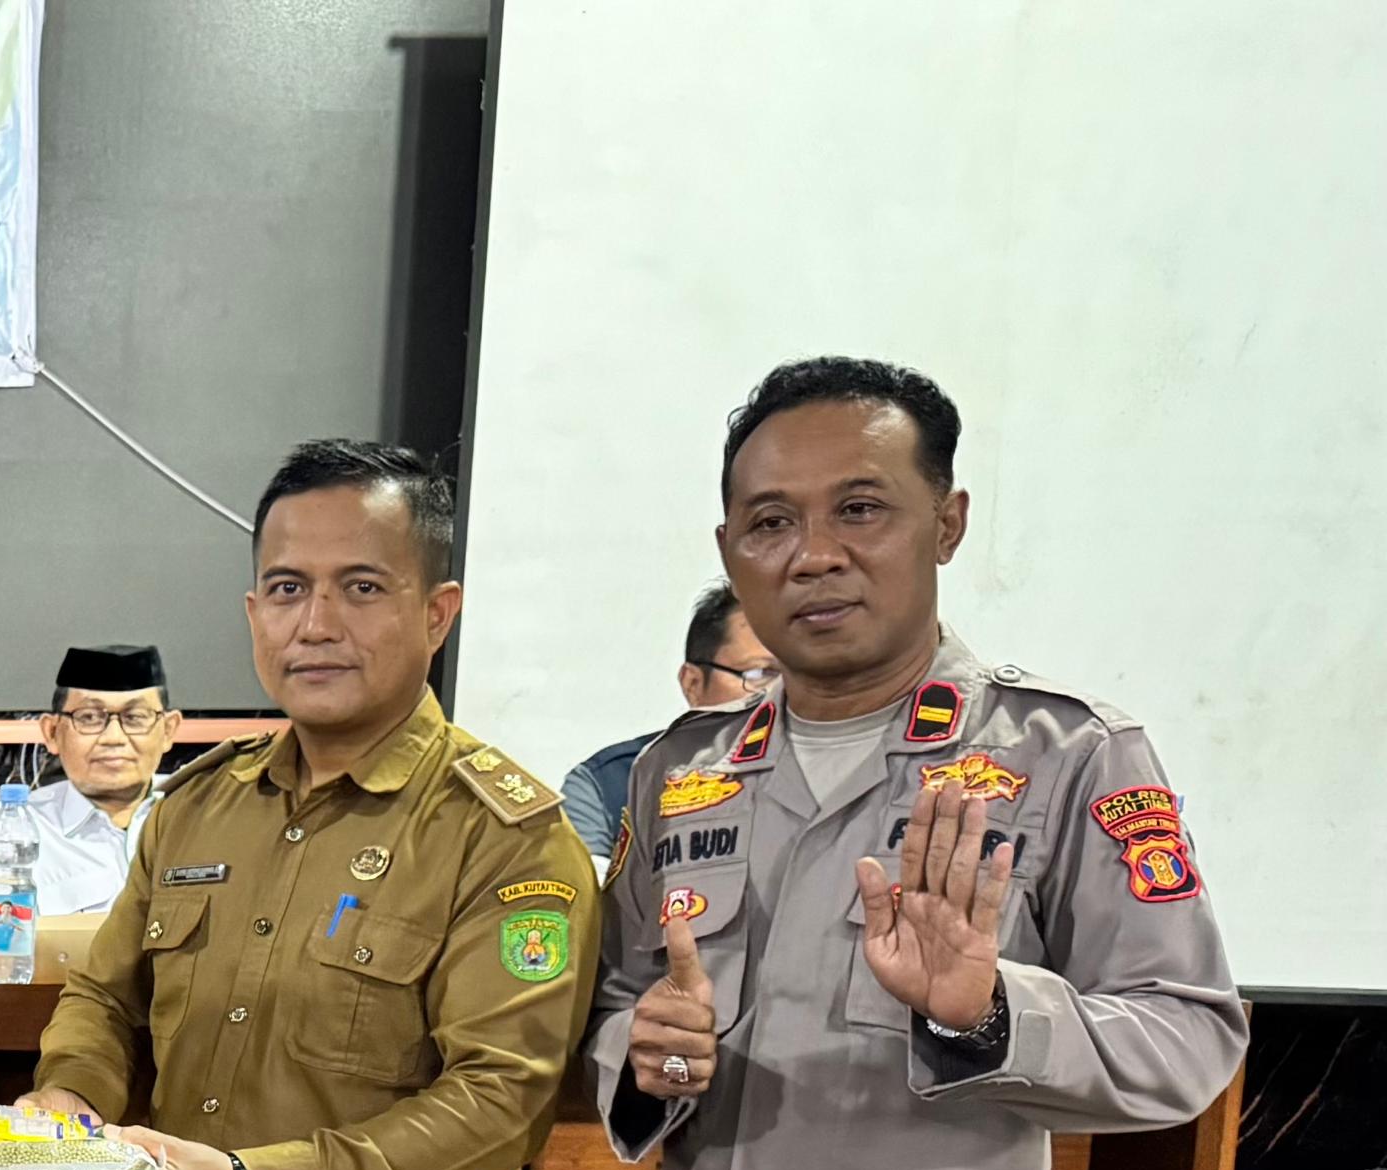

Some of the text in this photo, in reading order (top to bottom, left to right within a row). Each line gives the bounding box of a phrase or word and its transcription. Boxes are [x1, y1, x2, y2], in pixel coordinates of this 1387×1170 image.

[1099, 790, 1169, 814] POLRES
[1100, 802, 1138, 823] KUTAI
[690, 826, 739, 861] BUDI
[888, 818, 1027, 869] PRI
[523, 882, 550, 893] KUTAI
